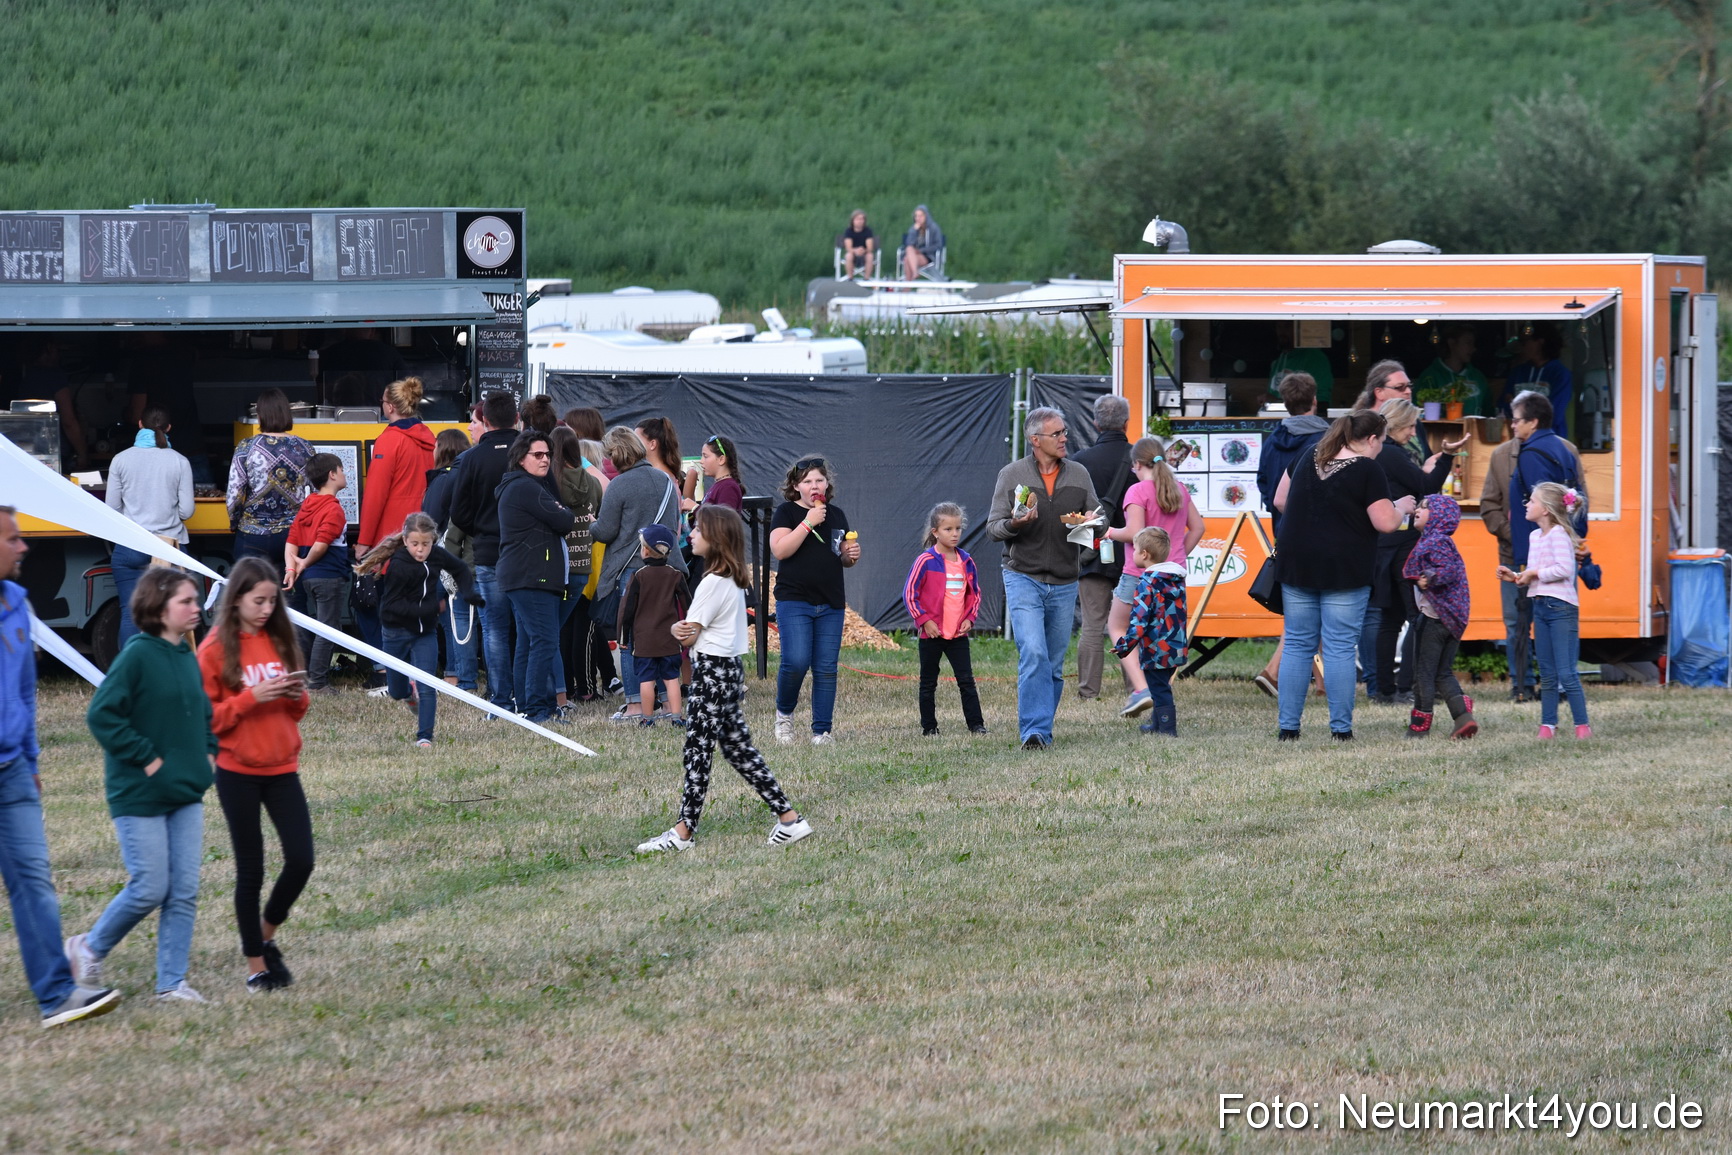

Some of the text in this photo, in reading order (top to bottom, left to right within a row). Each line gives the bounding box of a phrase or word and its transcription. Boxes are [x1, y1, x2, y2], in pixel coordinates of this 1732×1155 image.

[82, 219, 189, 279] BURGER
[212, 220, 311, 274] POMMES
[340, 217, 430, 276] SALAT
[494, 268, 508, 276] food
[484, 292, 523, 312] URGER
[487, 350, 516, 362] KÄSE
